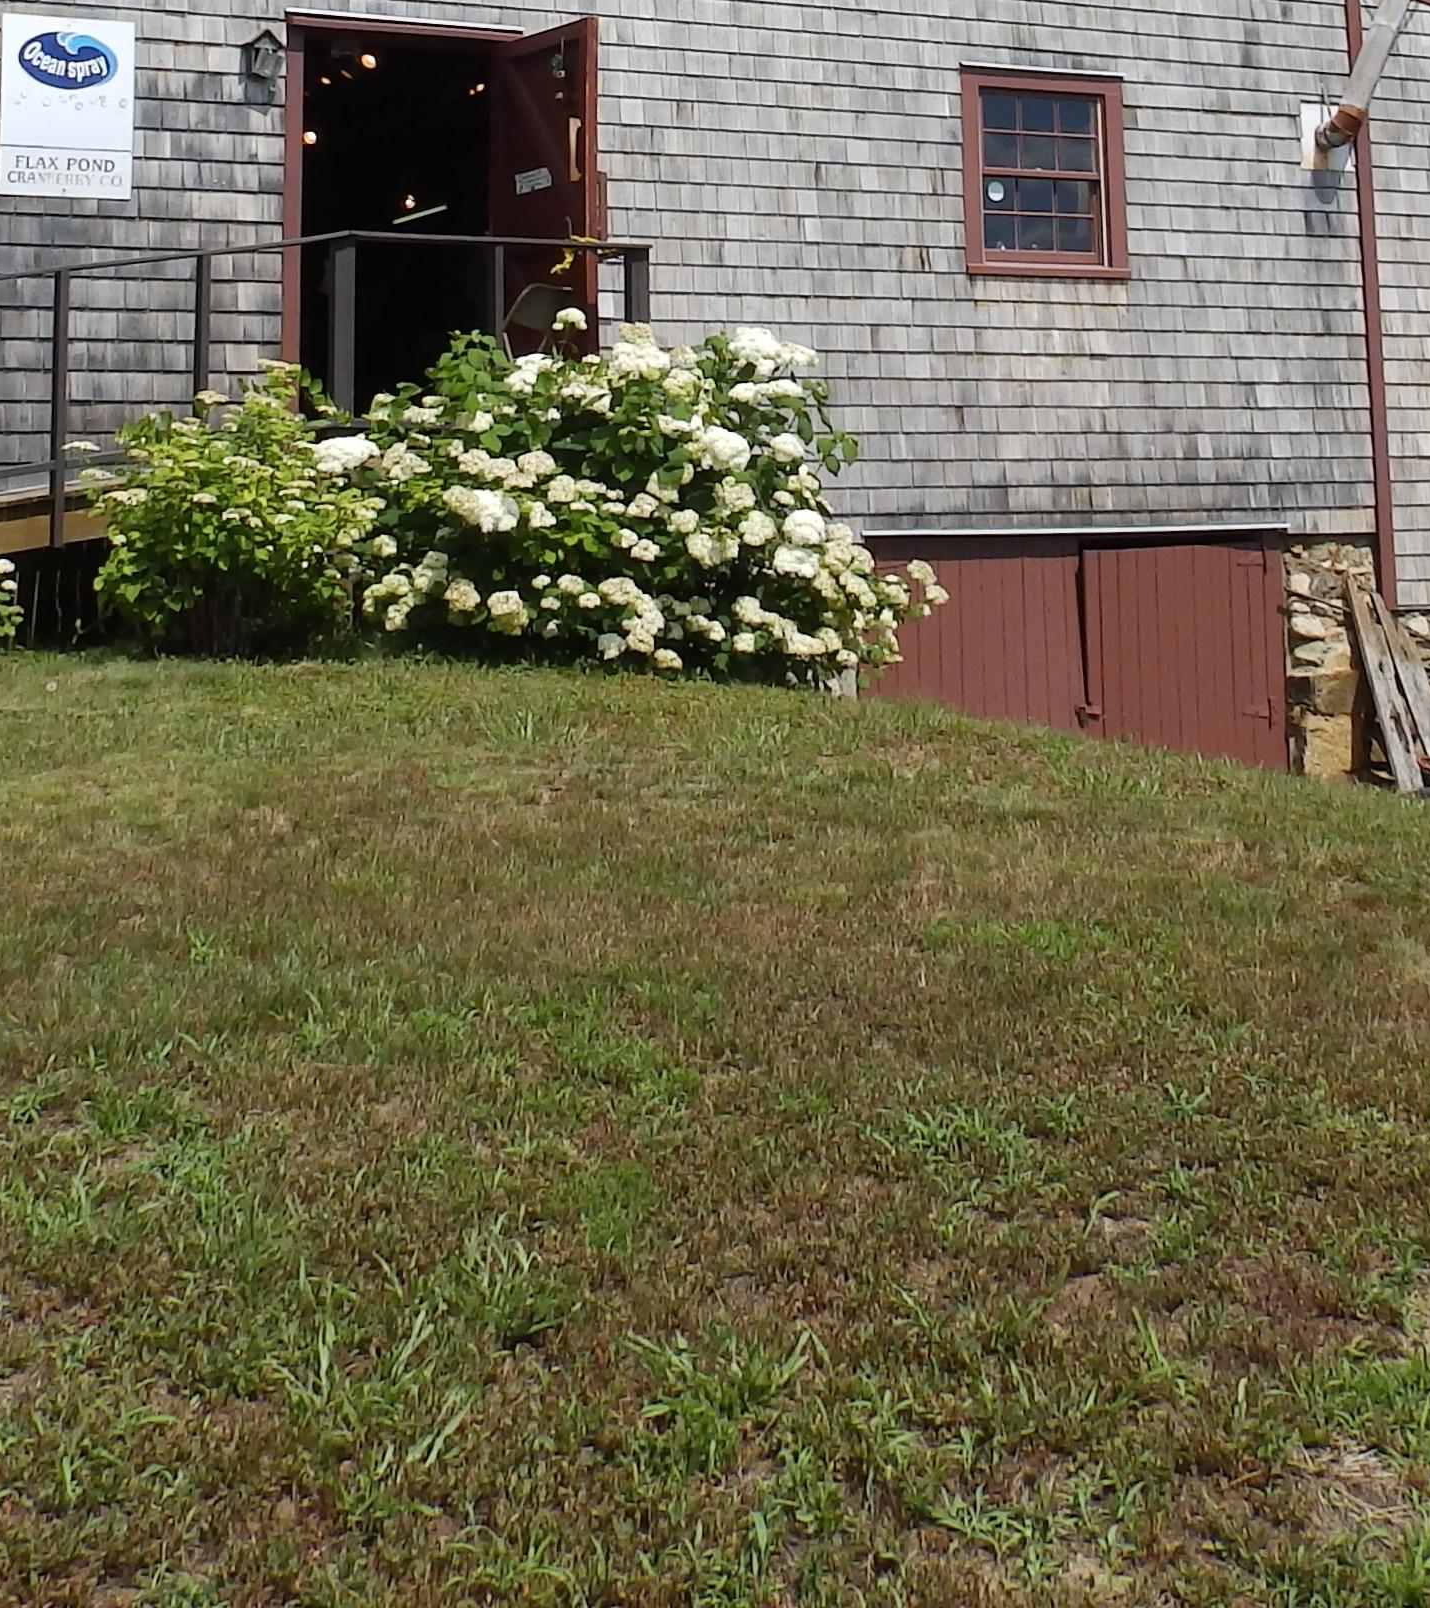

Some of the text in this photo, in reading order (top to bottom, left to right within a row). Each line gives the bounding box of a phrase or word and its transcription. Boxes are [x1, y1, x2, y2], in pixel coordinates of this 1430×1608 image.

[23, 41, 66, 76] Ocean
[15, 155, 115, 173] FLAX POND
